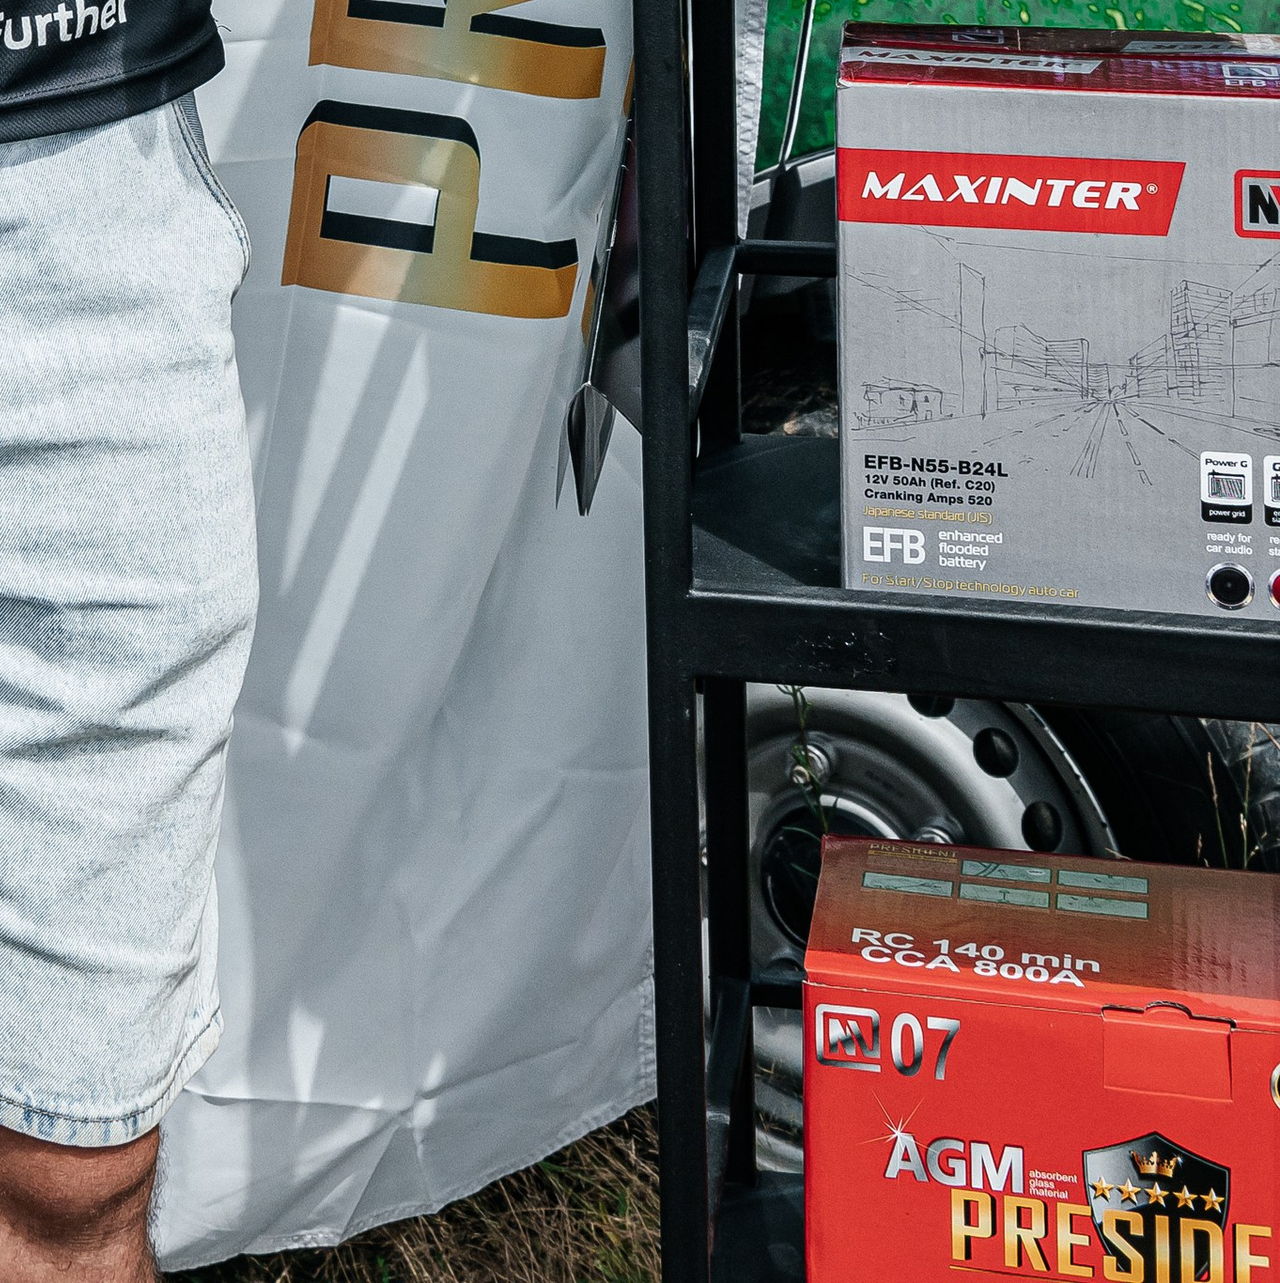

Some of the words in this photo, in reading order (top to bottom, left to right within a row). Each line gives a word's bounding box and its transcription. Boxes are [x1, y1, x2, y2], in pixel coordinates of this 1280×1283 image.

[863, 453, 1009, 478] EFB-N55-B24L
[1205, 458, 1238, 468] Power
[1240, 460, 1248, 468] G
[864, 473, 889, 485] 12V
[892, 475, 927, 488] 50Ah
[930, 477, 961, 490] (Ref.
[964, 479, 996, 493] C20)
[864, 488, 923, 504] Cranking
[927, 492, 964, 506] Amps
[968, 495, 993, 506] 520
[862, 504, 916, 520] Japanese
[917, 508, 965, 522] standard
[966, 511, 993, 525] (JIS)
[1208, 509, 1231, 517] power
[1231, 510, 1246, 519] grid
[862, 525, 926, 565] EFB
[938, 529, 1003, 544] enhanced
[1206, 532, 1234, 544] ready
[1237, 532, 1252, 543] for
[938, 542, 989, 556] flooded
[1205, 544, 1223, 553] car
[1224, 545, 1253, 555] audio
[938, 555, 987, 571] battery
[862, 573, 884, 585] For
[885, 574, 955, 591] Start/Stop
[955, 579, 1026, 596] technology
[1027, 585, 1058, 598] auto
[1059, 587, 1080, 599] car
[851, 926, 915, 949] RC
[932, 938, 1005, 961] 140
[1021, 951, 1101, 973] min
[860, 945, 961, 973] CCA
[973, 960, 1086, 988] 800A
[890, 1012, 961, 1081] 07
[884, 1131, 1024, 1194] AGM
[1028, 1168, 1078, 1184] absorbent
[1028, 1178, 1055, 1189] glass
[1028, 1187, 1069, 1200] material
